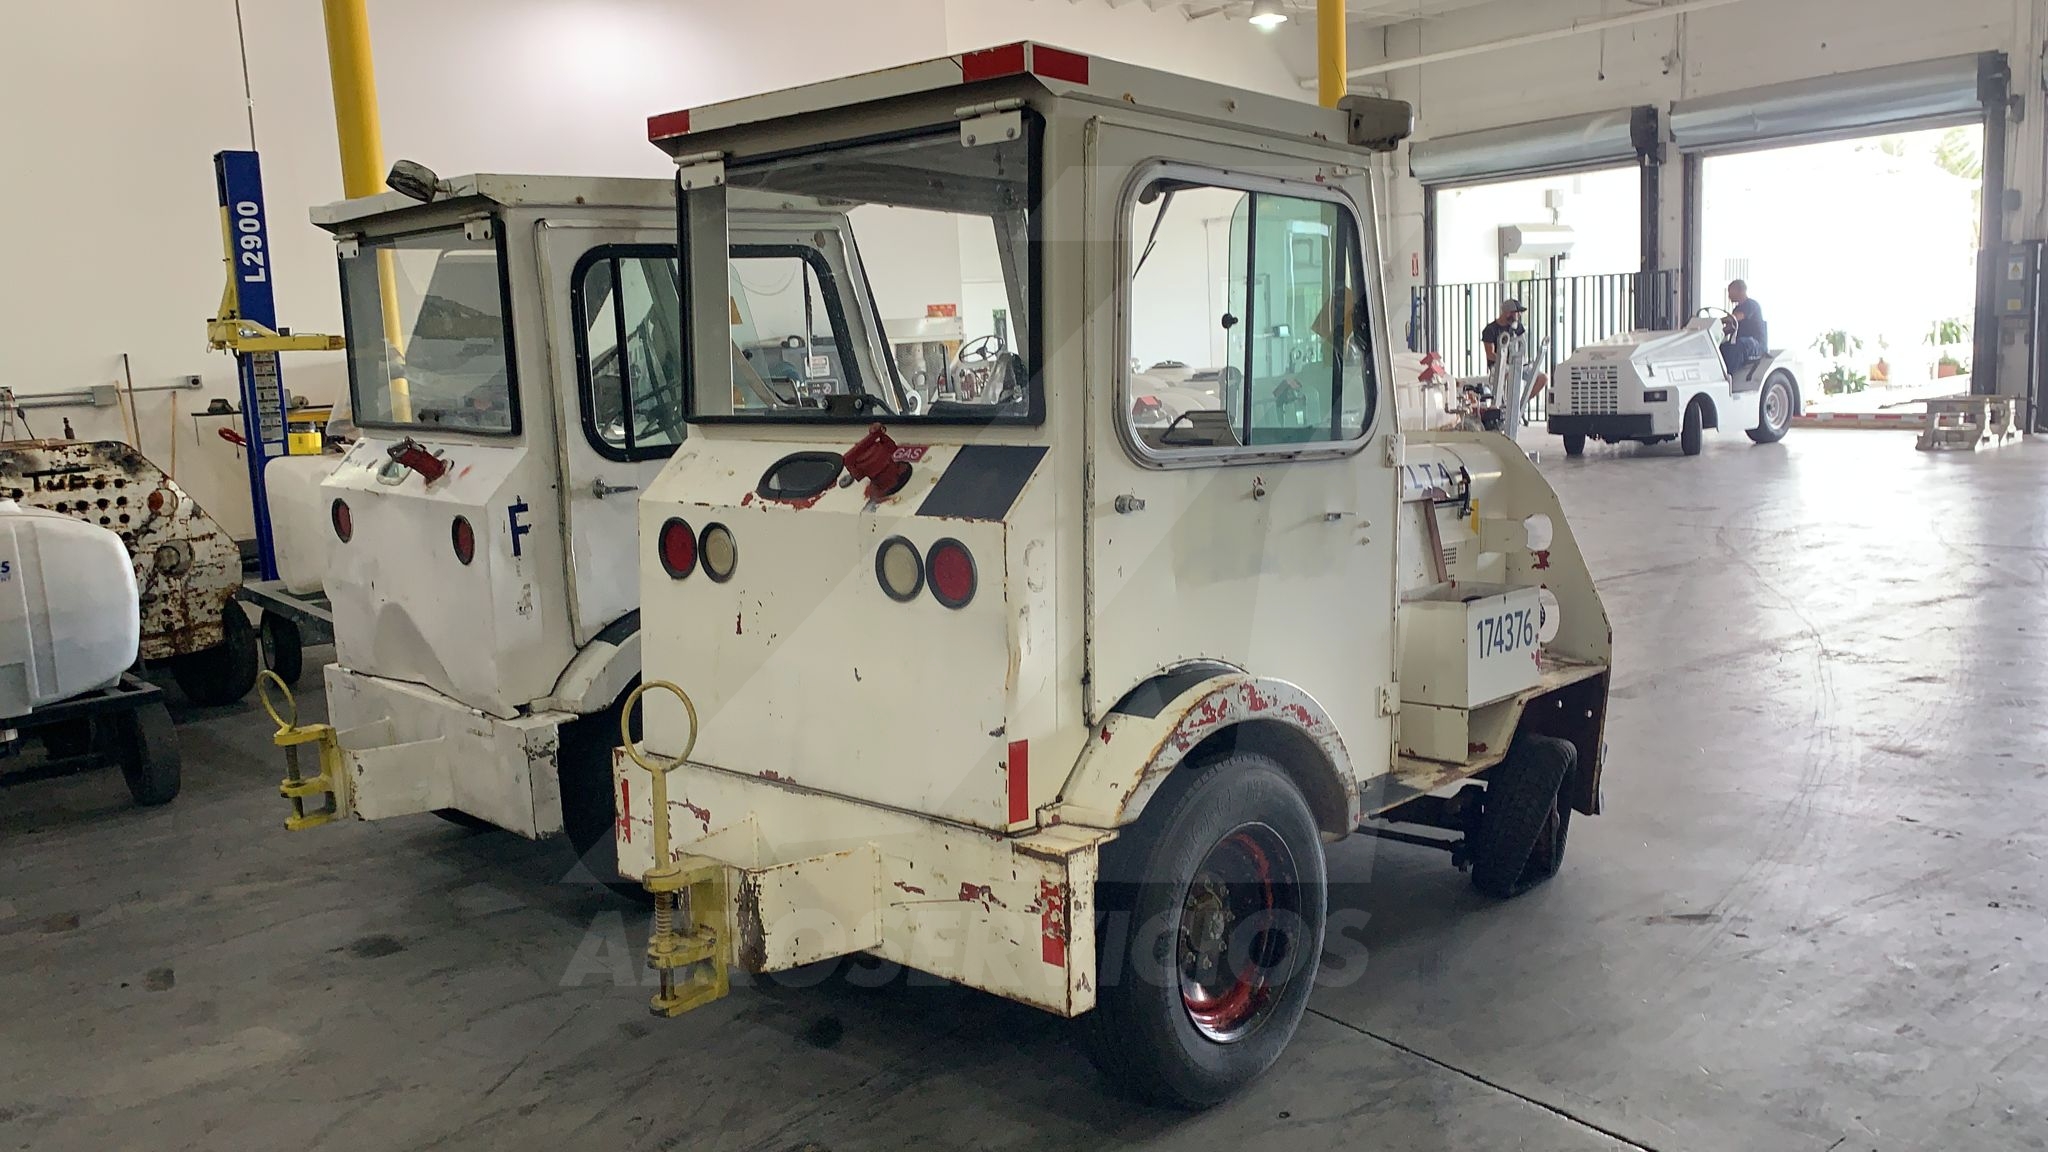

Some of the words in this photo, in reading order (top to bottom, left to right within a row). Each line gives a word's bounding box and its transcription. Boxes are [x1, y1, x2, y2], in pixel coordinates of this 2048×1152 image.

[236, 201, 266, 283] L2900
[1657, 362, 1701, 383] TUG
[893, 447, 922, 460] GAS
[1405, 462, 1453, 489] LTA
[508, 503, 529, 557] F
[1477, 608, 1533, 659] 174376
